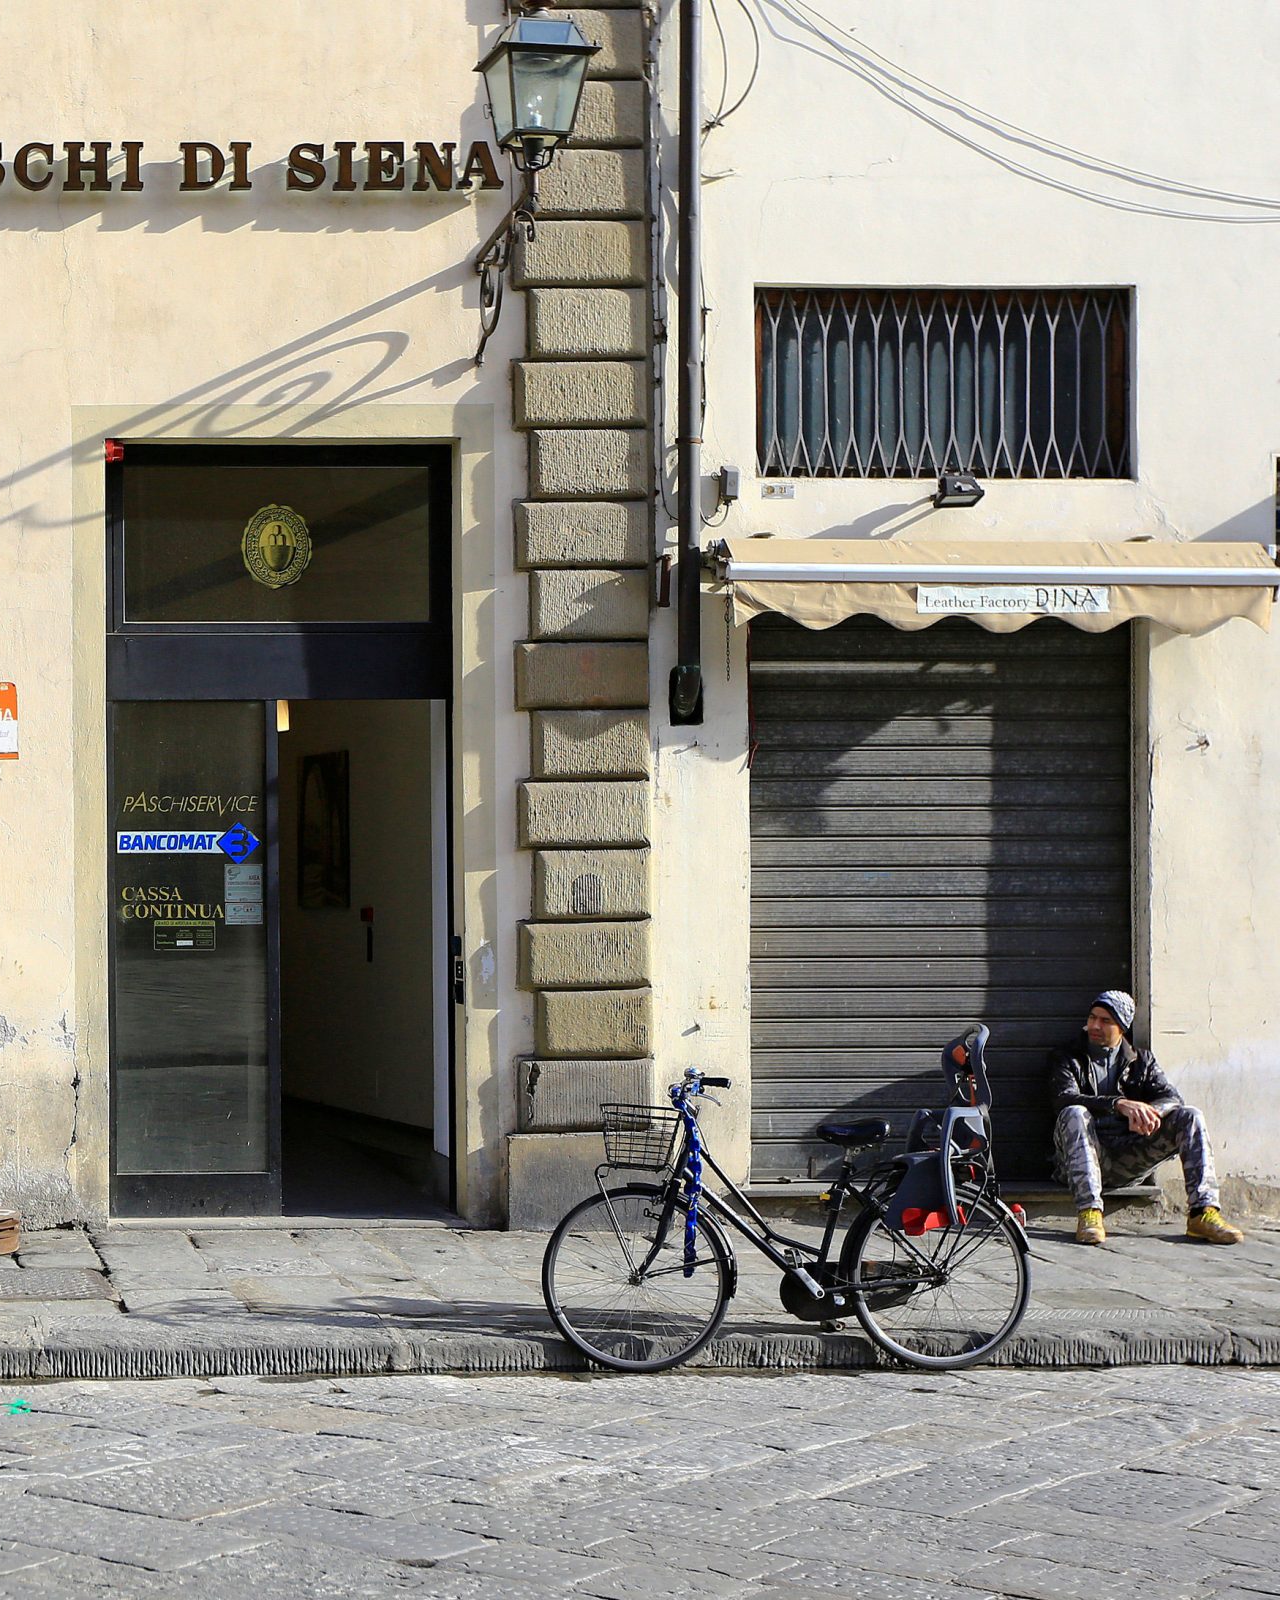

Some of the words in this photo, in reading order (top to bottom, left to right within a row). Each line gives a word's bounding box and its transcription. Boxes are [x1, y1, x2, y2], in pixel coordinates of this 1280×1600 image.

[180, 141, 252, 191] DI
[287, 141, 504, 191] SIENA
[925, 595, 976, 608] Leather
[980, 595, 1030, 611] Factory
[1035, 588, 1099, 607] DINA
[122, 791, 259, 817] PASCHISERVICE
[120, 834, 217, 851] BANCOMAT
[122, 887, 183, 901] CASSA
[122, 903, 224, 919] CONTINUA
